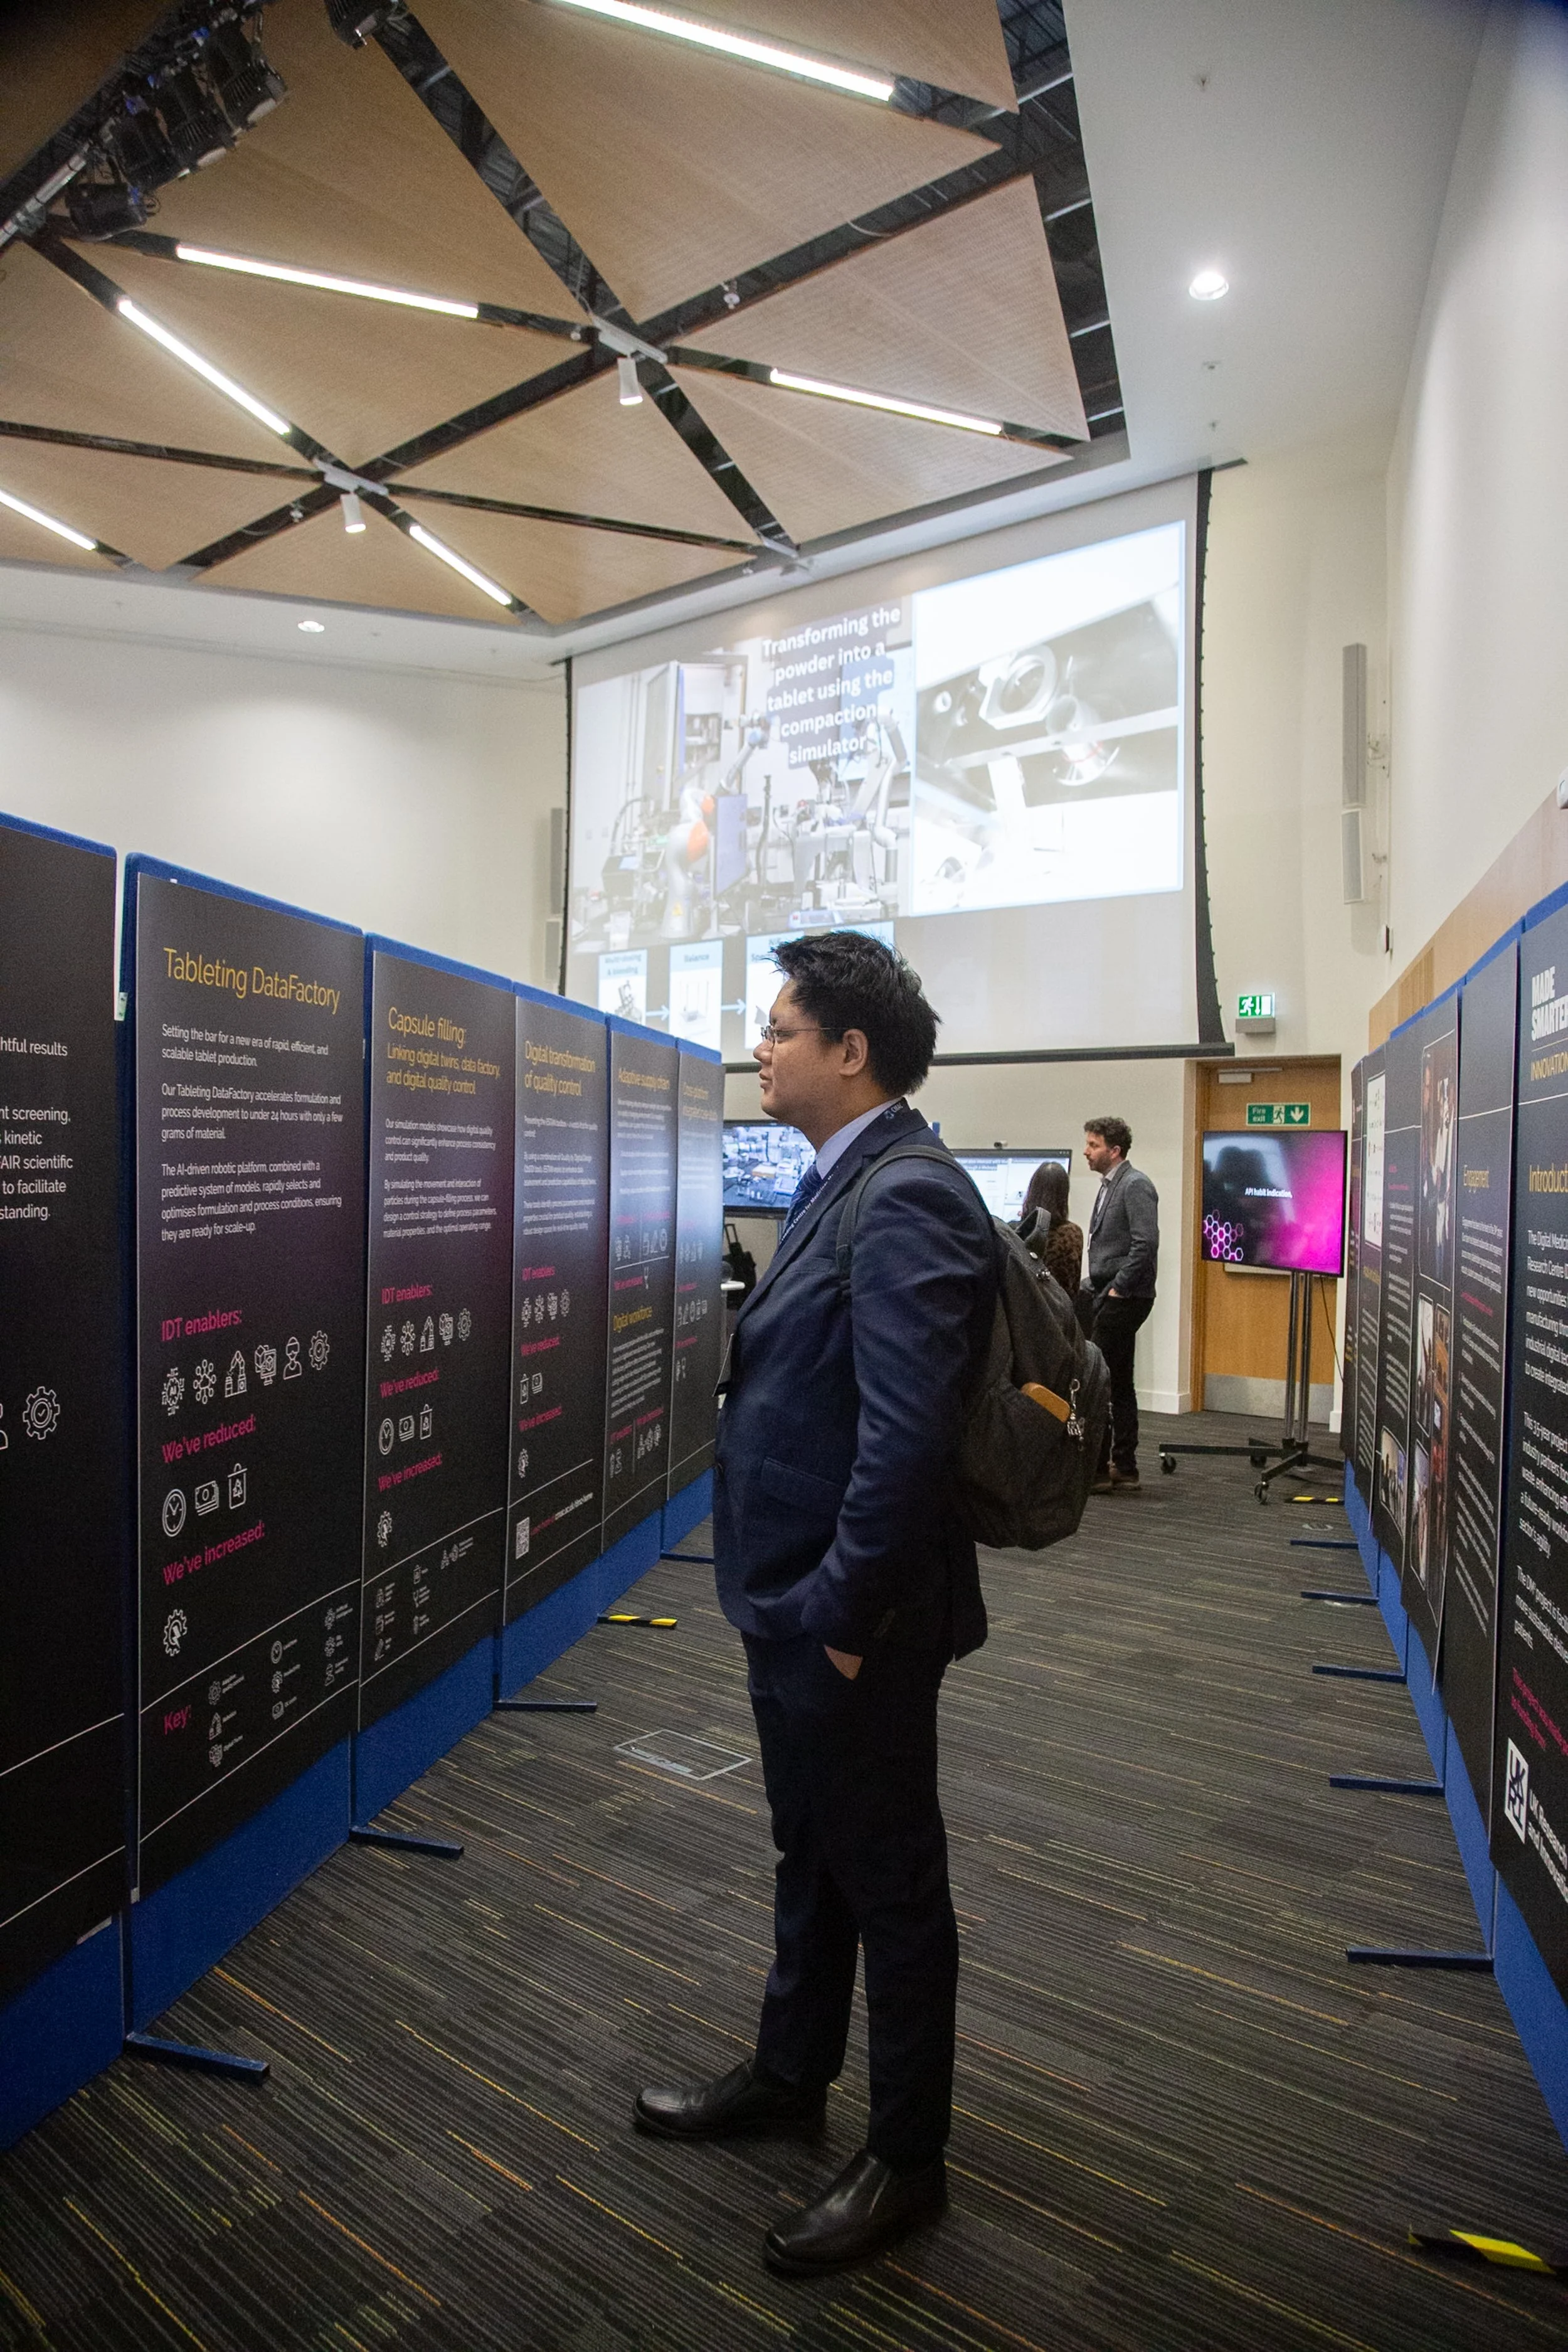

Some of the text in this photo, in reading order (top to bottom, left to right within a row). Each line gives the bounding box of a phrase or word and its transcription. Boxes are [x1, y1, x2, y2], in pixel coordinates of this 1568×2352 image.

[762, 607, 901, 657] Transforming the
[774, 641, 885, 686] powder into a
[767, 669, 893, 712] tablet using the
[780, 703, 877, 735] compaction
[789, 733, 867, 764] simulator
[684, 954, 709, 963] Balance
[164, 947, 341, 1015] Tableting DataFactory
[1532, 966, 1555, 1008] MADE
[388, 1006, 435, 1038] Capsule
[30, 1042, 68, 1056] results
[162, 1024, 329, 1055] Setting the bar for new era of and
[162, 1046, 194, 1061] scalable
[195, 1050, 217, 1063] tablet
[387, 1042, 476, 1072] Linking digital data
[525, 1040, 596, 1073] Digital transformation
[386, 1070, 476, 1095] and digital quality control
[524, 1070, 582, 1097] of quality control
[161, 1083, 341, 1105] Our Tableting DataFactory accelerates formulation and
[161, 1106, 343, 1124] process development to under hours with only few
[395, 1119, 457, 1132] simulation models showcase
[4, 1131, 42, 1145] kinetic
[161, 1129, 185, 1142] grams
[186, 1127, 194, 1139] of
[385, 1136, 401, 1145] control
[411, 1136, 438, 1149] significantly
[23, 1154, 73, 1169] scientific
[161, 1163, 176, 1176] The
[177, 1163, 211, 1176] AI-driven
[211, 1162, 236, 1174] robotic
[269, 1161, 301, 1173] combined
[302, 1161, 315, 1172] with
[395, 1152, 412, 1163] product
[3, 1179, 66, 1194] to facilitate
[161, 1178, 321, 1201] predictive system of rapidly selects and
[391, 1179, 415, 1191] simulating
[161, 1195, 342, 1221] optimises formulation and process ensuring
[384, 1195, 419, 1207] particles during
[384, 1213, 400, 1224] design
[793, 1210, 806, 1224] Centre
[161, 1228, 177, 1243] they
[178, 1227, 191, 1239] are
[191, 1223, 212, 1239] ready
[213, 1222, 224, 1235] for
[1528, 1230, 1552, 1250] The Digital
[1527, 1255, 1564, 1278] Research Centre
[381, 1287, 395, 1304] IDT
[1537, 1288, 1566, 1307] opportunities
[161, 1309, 242, 1341] IDT enablers:
[1527, 1312, 1558, 1337] manufacturing
[1525, 1334, 1560, 1364] industrial digital
[1531, 1366, 1545, 1382] create
[1523, 1412, 1533, 1431] This
[162, 1413, 256, 1464] We've reduced:
[1523, 1437, 1560, 1477] industry partners
[163, 1519, 265, 1586] We've increased:
[1517, 1565, 1526, 1586] The
[1528, 1821, 1540, 1851] and
[1529, 1789, 1567, 1871] UK Research
